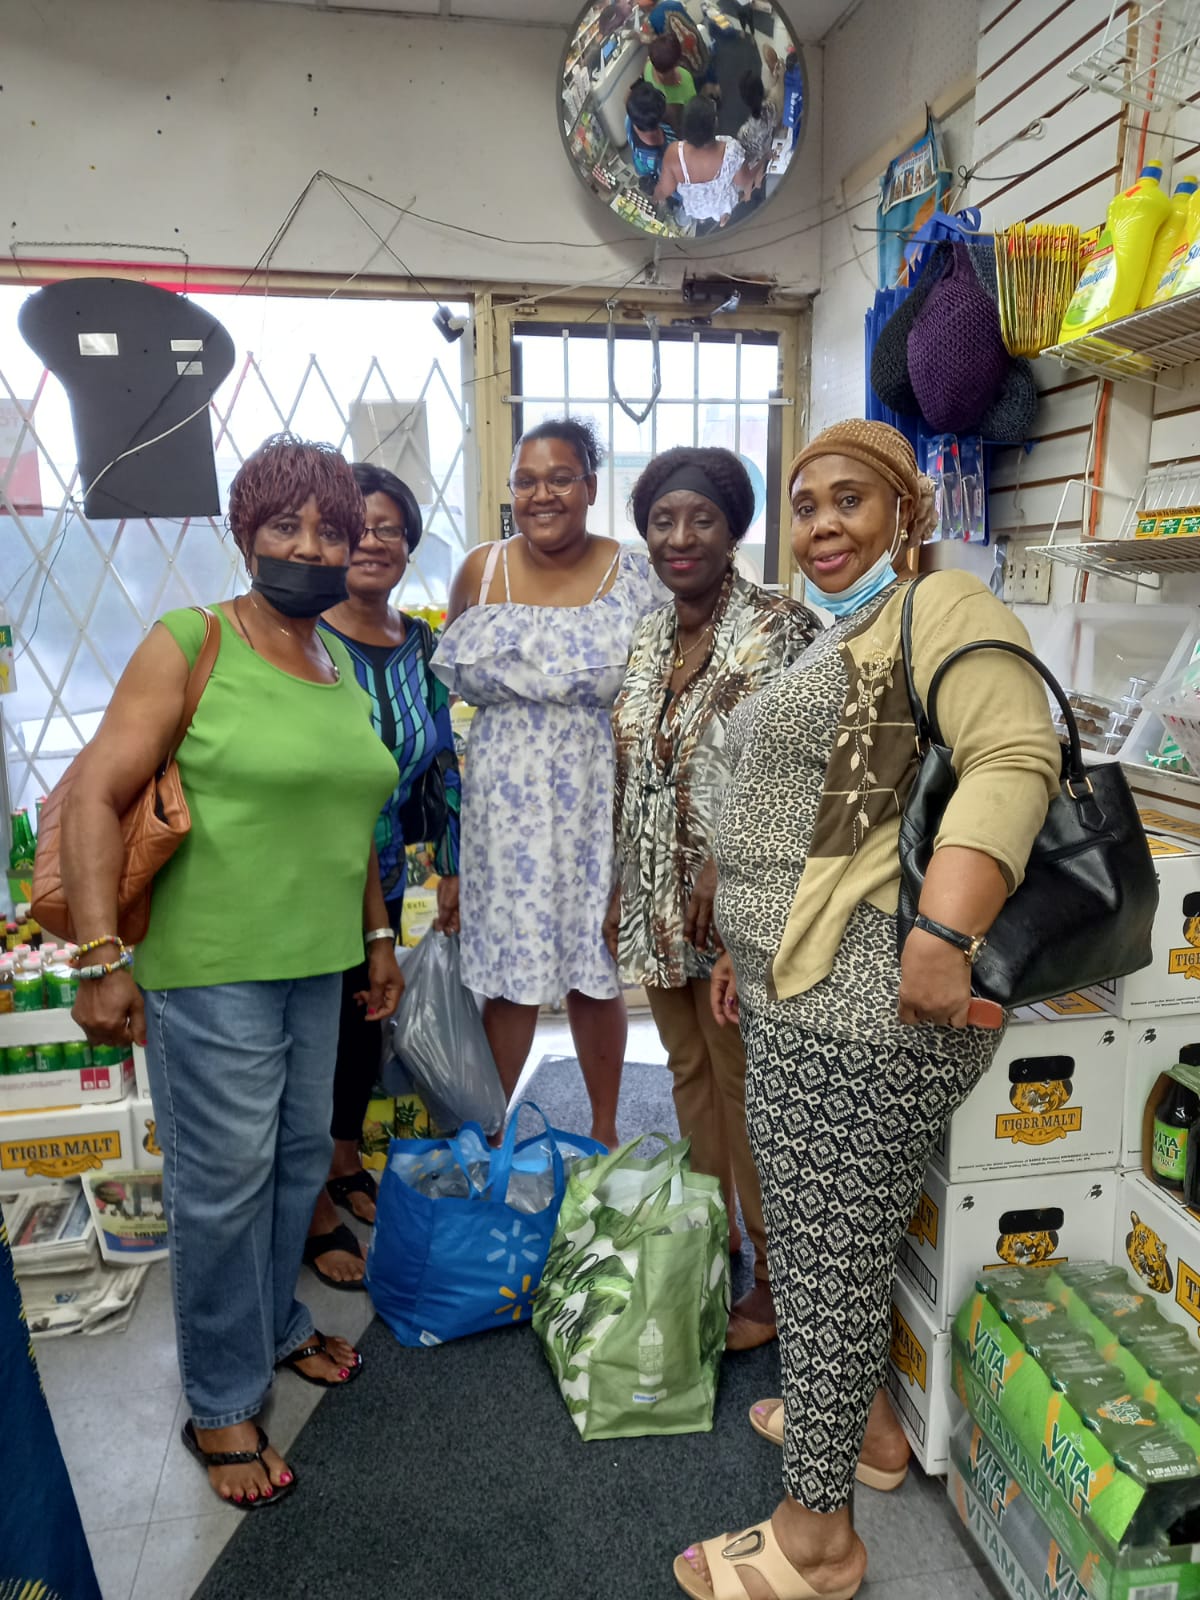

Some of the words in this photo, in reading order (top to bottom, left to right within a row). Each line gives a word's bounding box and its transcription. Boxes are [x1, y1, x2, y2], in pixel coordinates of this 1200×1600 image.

[8, 1142, 62, 1161] TIGER
[64, 1137, 112, 1156] MALT
[1002, 1117, 1039, 1131] TIGER
[1041, 1113, 1076, 1127] MALT
[966, 1338, 1005, 1402] MALT
[973, 1320, 1007, 1385] VITA
[971, 1380, 1049, 1513] VITAMALT
[976, 1437, 1007, 1501] VITA
[1051, 1422, 1090, 1499] VITA
[968, 1454, 1006, 1525] MALT
[1040, 1442, 1090, 1519] MALT
